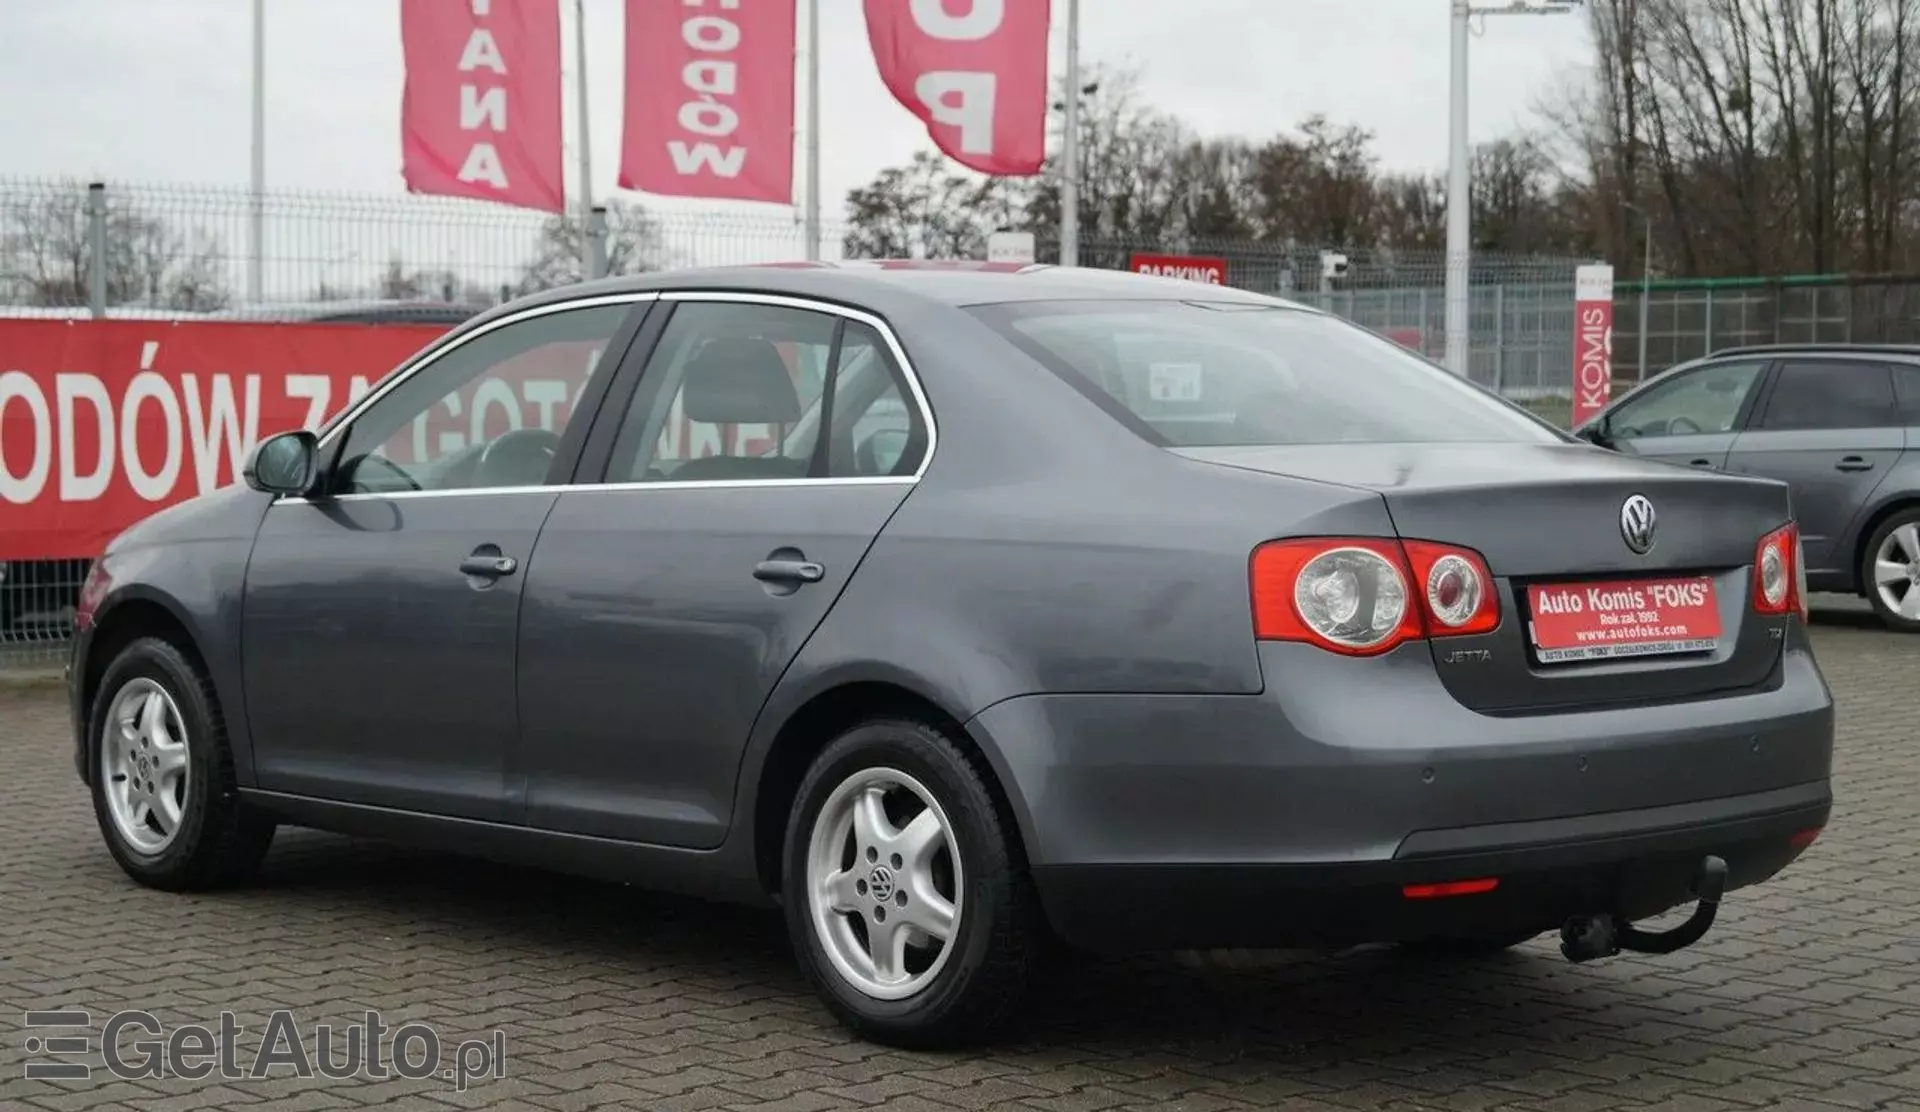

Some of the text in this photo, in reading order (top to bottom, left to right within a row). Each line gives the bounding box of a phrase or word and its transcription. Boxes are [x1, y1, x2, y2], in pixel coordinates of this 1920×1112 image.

[1581, 308, 1604, 408] KOMIS
[1539, 590, 1583, 614] Auto
[1587, 587, 1645, 611] Komis
[1600, 612, 1619, 625] Rok
[1576, 624, 1688, 641] www.autofoks.com
[1442, 650, 1492, 662] JETTA
